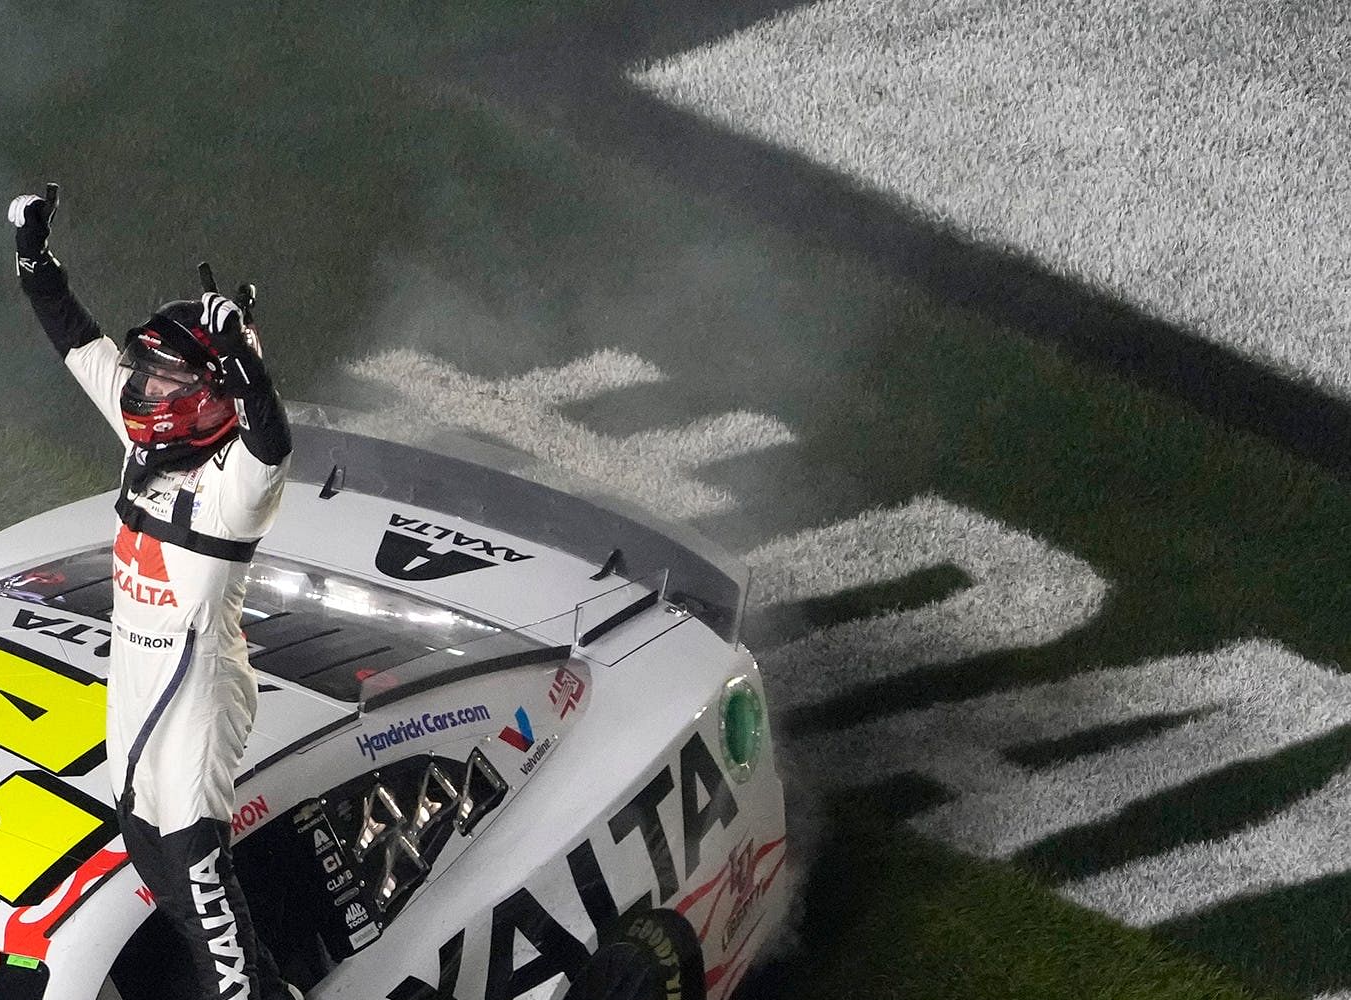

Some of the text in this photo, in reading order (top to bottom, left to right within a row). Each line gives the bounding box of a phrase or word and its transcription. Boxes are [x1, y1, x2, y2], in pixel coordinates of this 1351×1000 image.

[389, 513, 536, 562] AXALTA
[113, 564, 178, 608] XALTA
[129, 632, 174, 648] BYRON
[230, 795, 270, 837] RON
